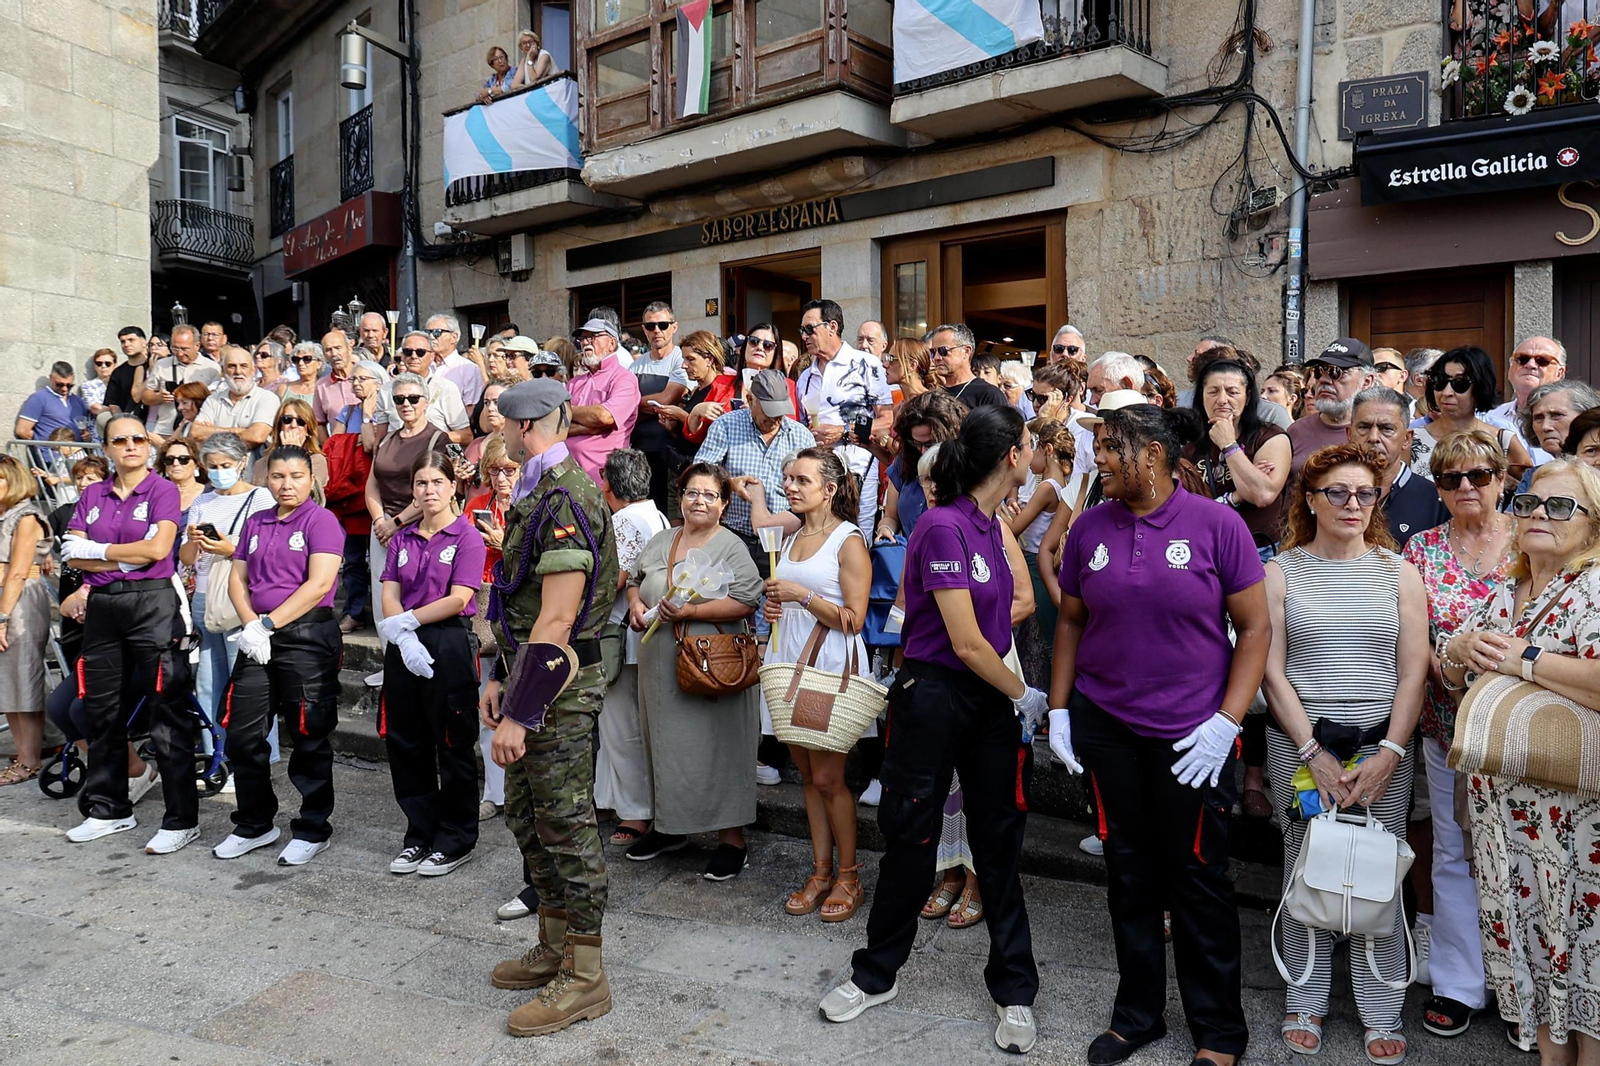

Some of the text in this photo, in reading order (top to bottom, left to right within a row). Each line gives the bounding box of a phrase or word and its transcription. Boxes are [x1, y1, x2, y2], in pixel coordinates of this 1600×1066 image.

[1372, 85, 1409, 97] PRAZA
[1384, 99, 1397, 108] DA
[1360, 110, 1407, 124] IGREXA
[1388, 162, 1468, 187] Estrella
[1471, 152, 1548, 177] Galicia
[701, 197, 840, 244] SABOR A ESPAÑA
